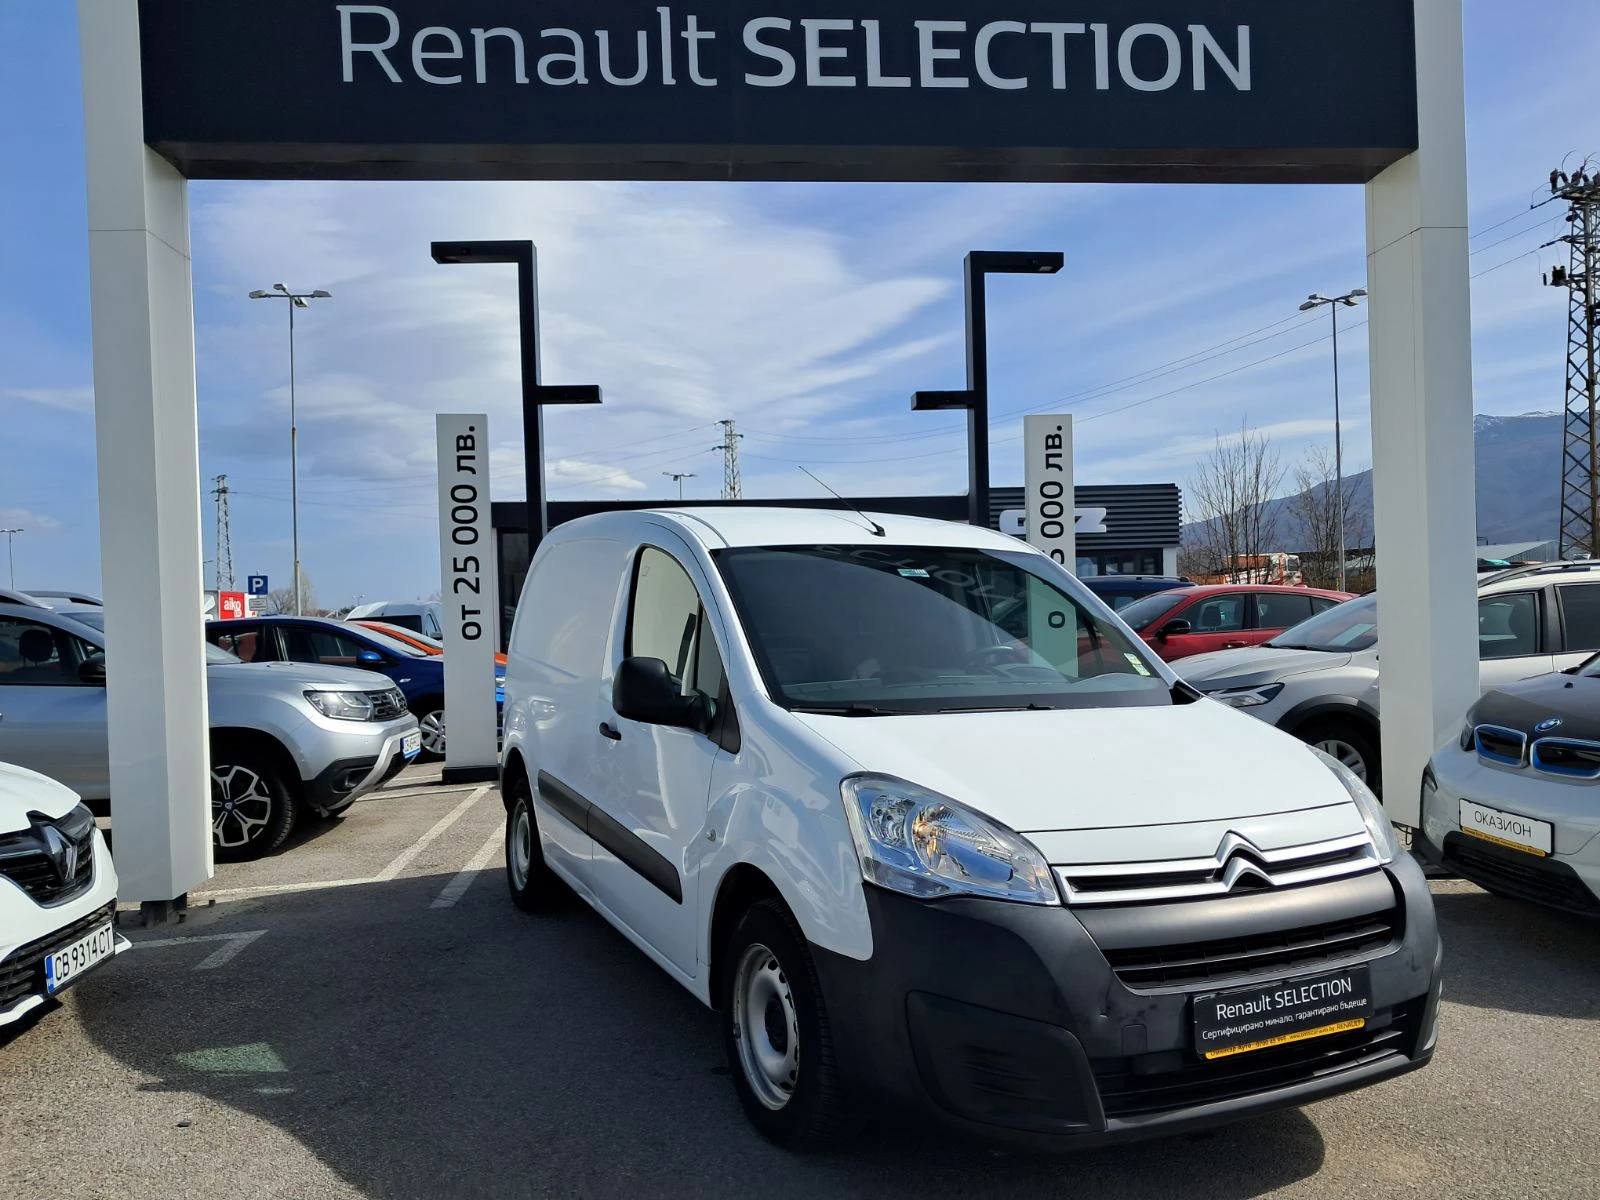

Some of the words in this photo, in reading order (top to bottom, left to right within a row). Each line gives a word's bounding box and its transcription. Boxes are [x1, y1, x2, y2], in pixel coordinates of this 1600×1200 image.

[336, 4, 718, 86] Renault
[742, 16, 1252, 92] SELECTION
[455, 425, 477, 475] лв.
[1044, 424, 1064, 472] лв.
[450, 484, 479, 546] 000
[1039, 480, 1065, 539] 000
[453, 555, 481, 595] 25
[461, 604, 482, 641] от
[1474, 810, 1532, 838] ОКАЗИОН
[1202, 1020, 1264, 1040] Сертифицирано
[1265, 1014, 1294, 1029] минало,
[1295, 1004, 1339, 1021] гарантирано
[1339, 997, 1367, 1010] бъдеще
[1216, 994, 1272, 1021] Renault
[1274, 976, 1352, 1009] SELECTION
